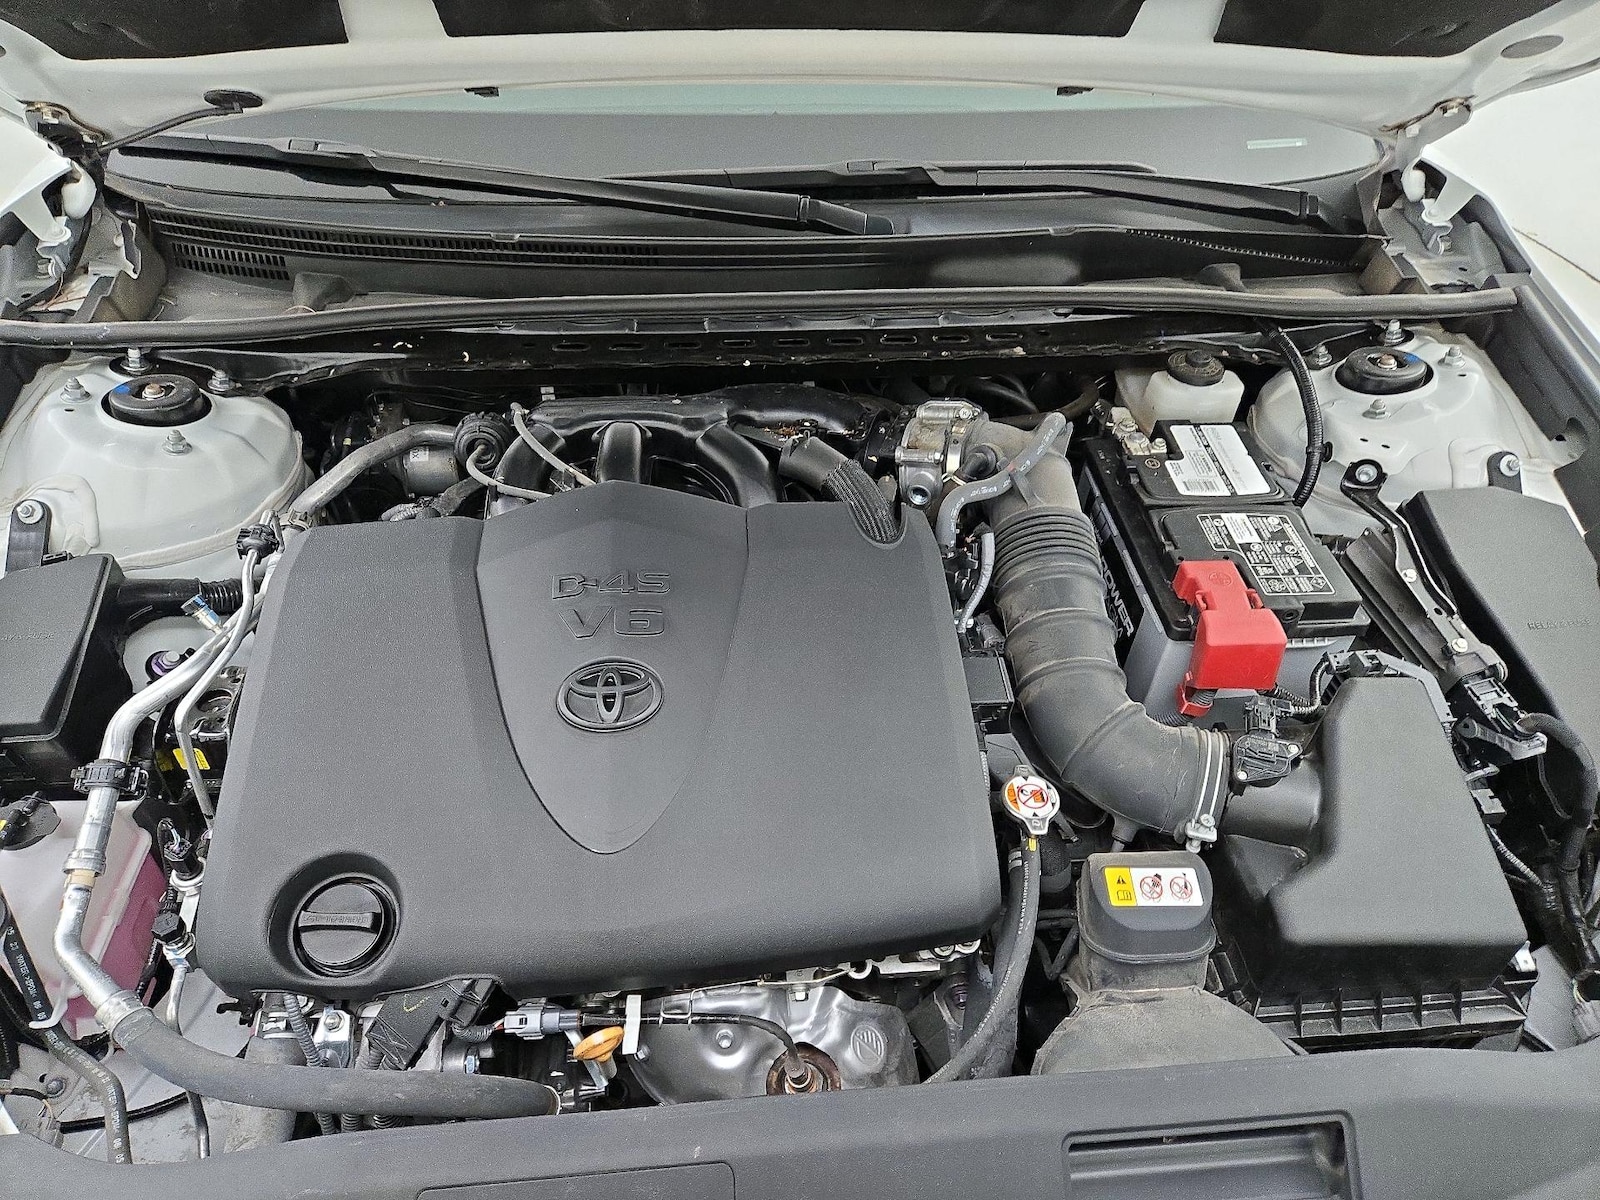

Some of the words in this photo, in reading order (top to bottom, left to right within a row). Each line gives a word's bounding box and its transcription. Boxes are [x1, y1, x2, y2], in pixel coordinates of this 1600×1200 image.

[551, 569, 671, 600] D-4S
[558, 604, 665, 639] V6
[16, 953, 30, 976] WATER
[107, 1081, 118, 1106] WATER
